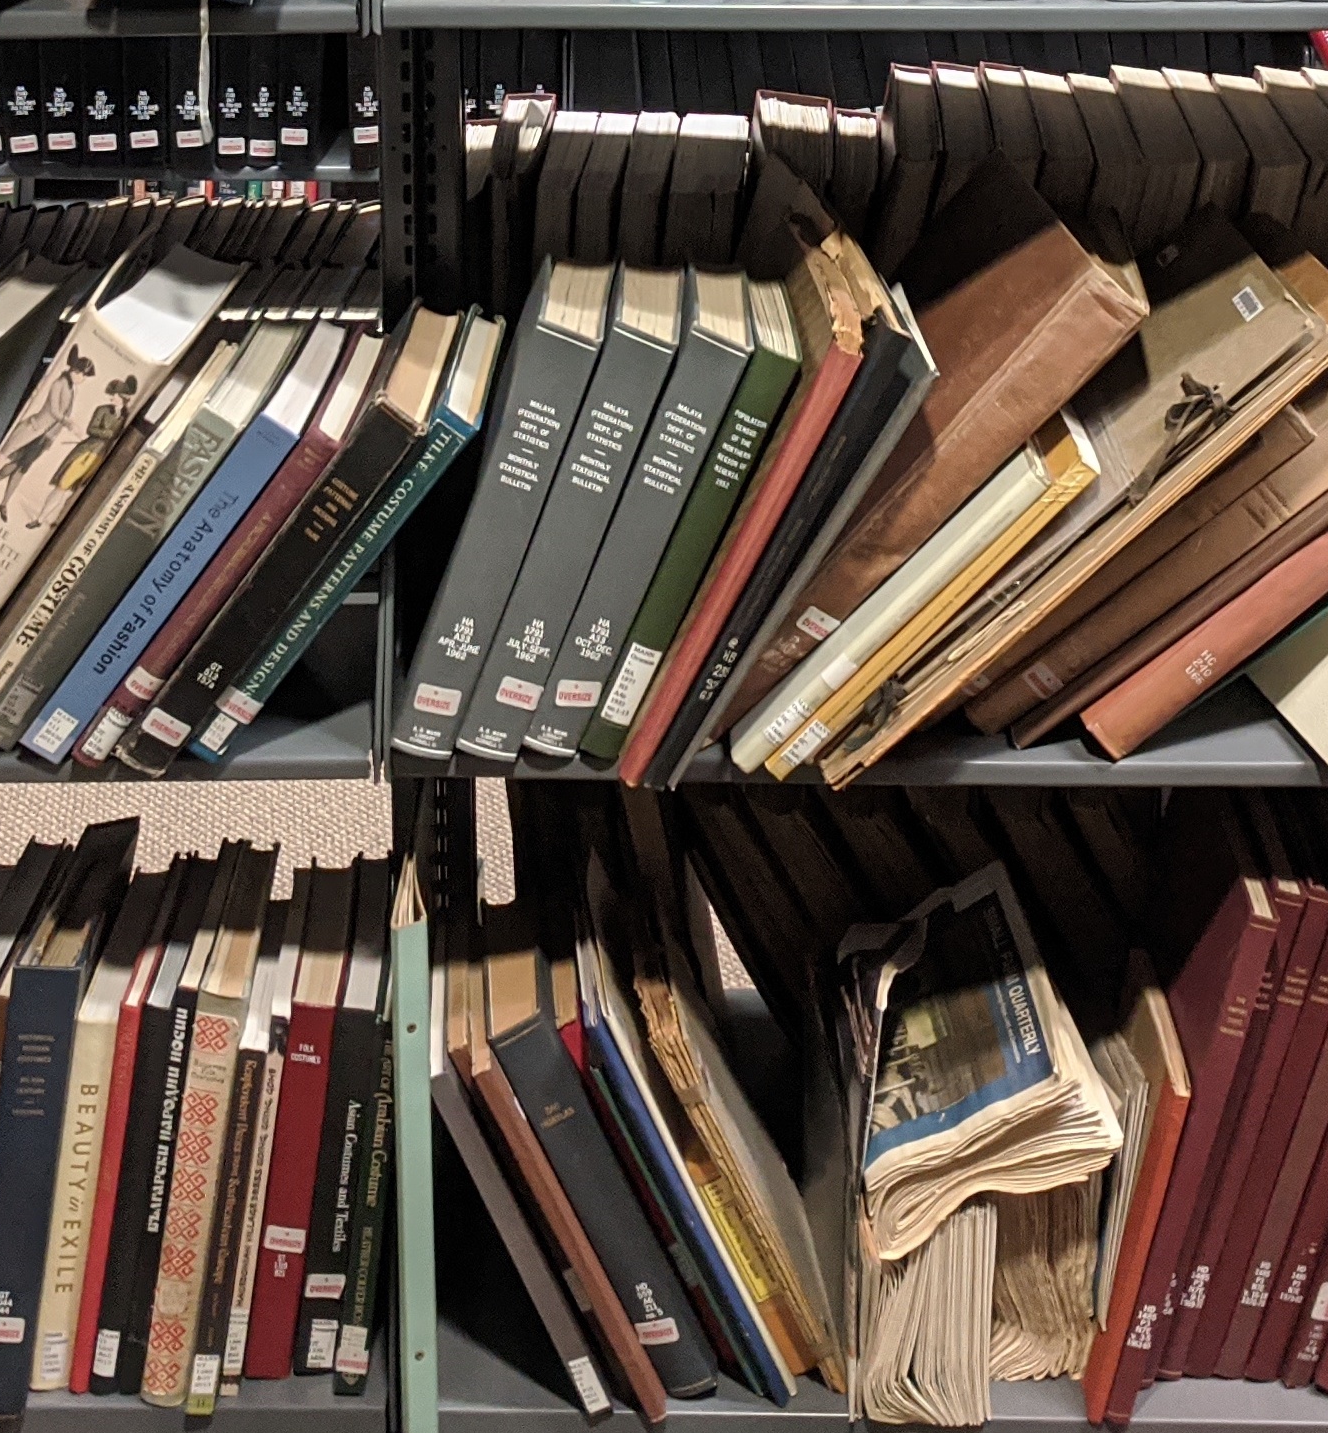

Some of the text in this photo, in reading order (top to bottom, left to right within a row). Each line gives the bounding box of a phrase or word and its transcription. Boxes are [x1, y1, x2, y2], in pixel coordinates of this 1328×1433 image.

[81, 537, 99, 557] OF
[285, 430, 453, 644] TILKE COSTUME PATTERNS AND
[16, 554, 88, 649] COSTUME
[92, 490, 240, 676] The Anatomy of Fashion
[1192, 657, 1212, 677] 240
[1200, 649, 1217, 667] HC
[1008, 984, 1043, 1056] QUARTERLY
[146, 1006, 190, 1233] БЪЛГАРСКИ НАРОДНИ НОСИИ
[345, 1099, 362, 1130] Asian
[54, 1083, 100, 1294] BEAUTY EXILE
[339, 1131, 358, 1186] Costumes
